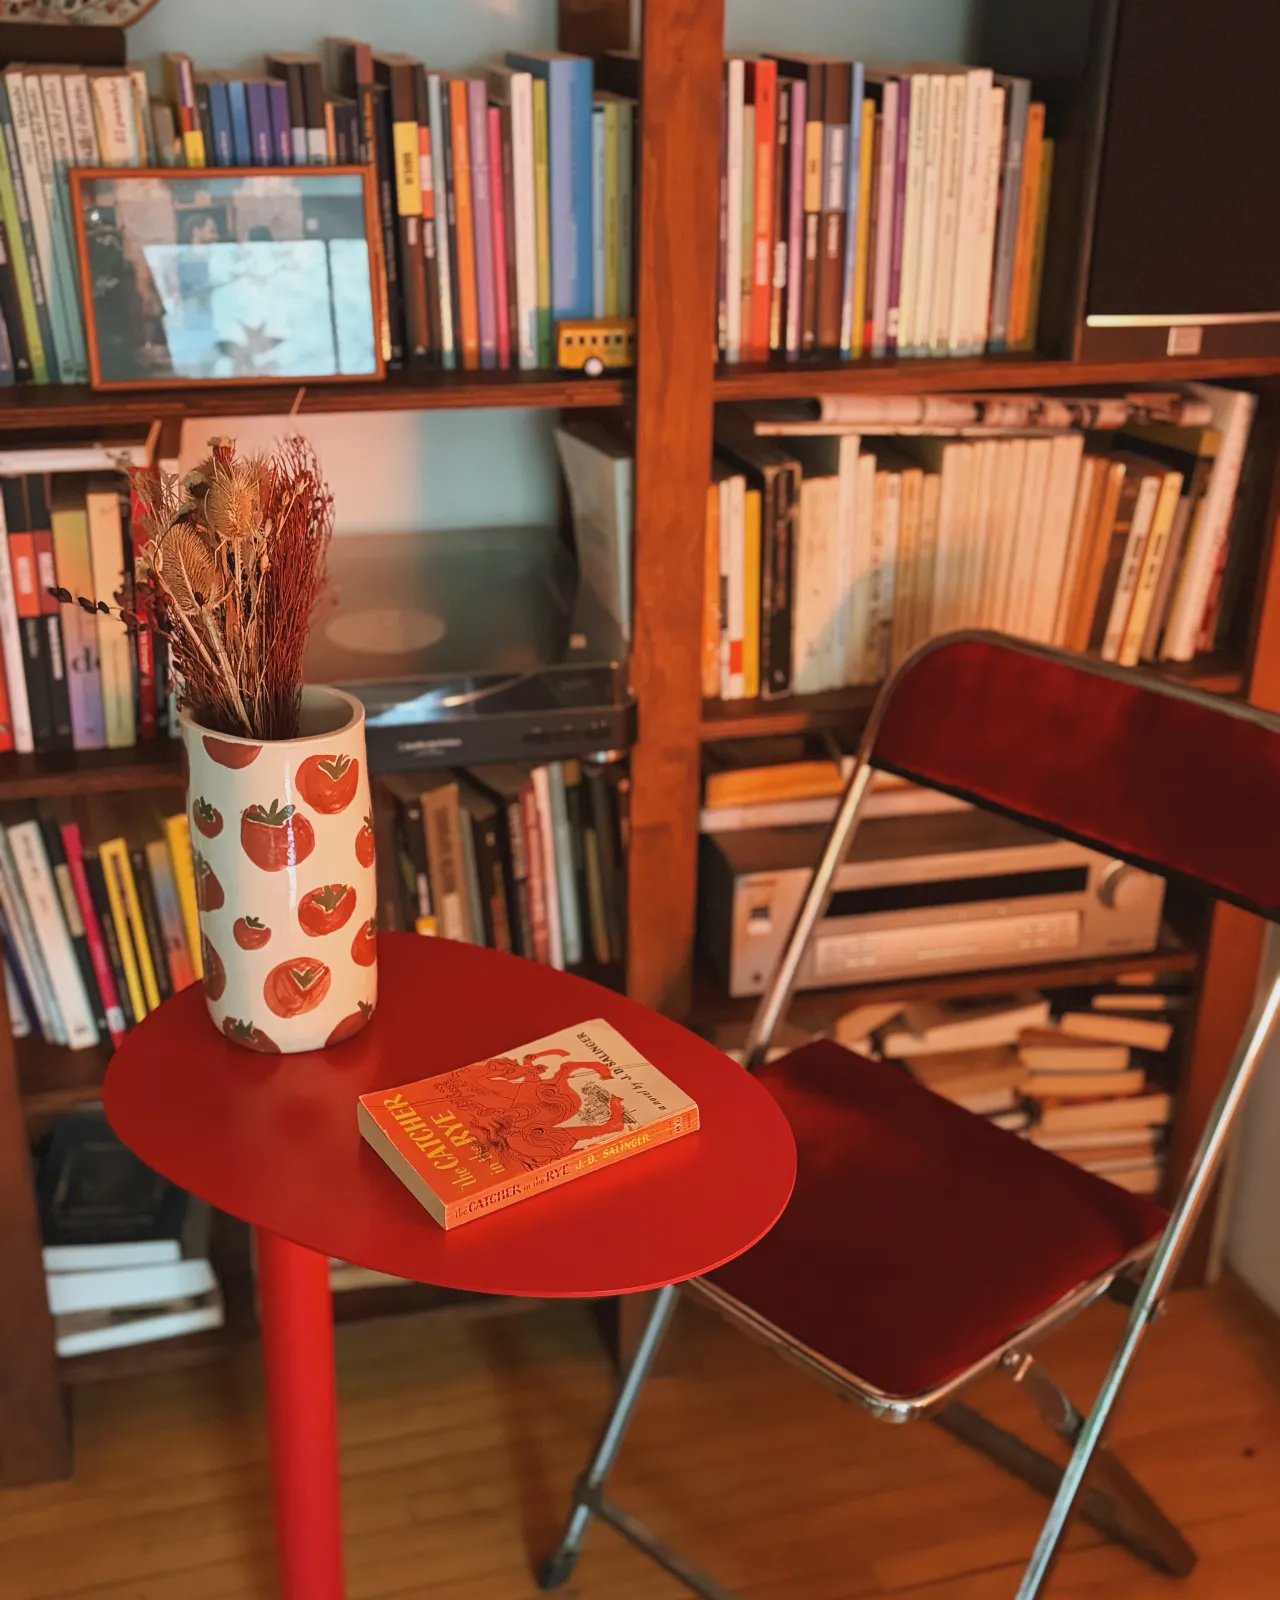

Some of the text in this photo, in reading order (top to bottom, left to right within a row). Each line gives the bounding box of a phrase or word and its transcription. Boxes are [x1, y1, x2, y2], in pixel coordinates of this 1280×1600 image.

[576, 1031, 617, 1068] SALINGER
[613, 1065, 625, 1075] D.
[620, 1073, 632, 1081] J.
[631, 1081, 644, 1091] by
[638, 1090, 662, 1107] novel
[383, 1093, 477, 1192] the CATCHER
[430, 1109, 506, 1176] in the RYE
[575, 1159, 585, 1170] J.
[602, 1133, 651, 1159] SALINGER
[455, 1164, 570, 1219] the CATCHER in the RYE
